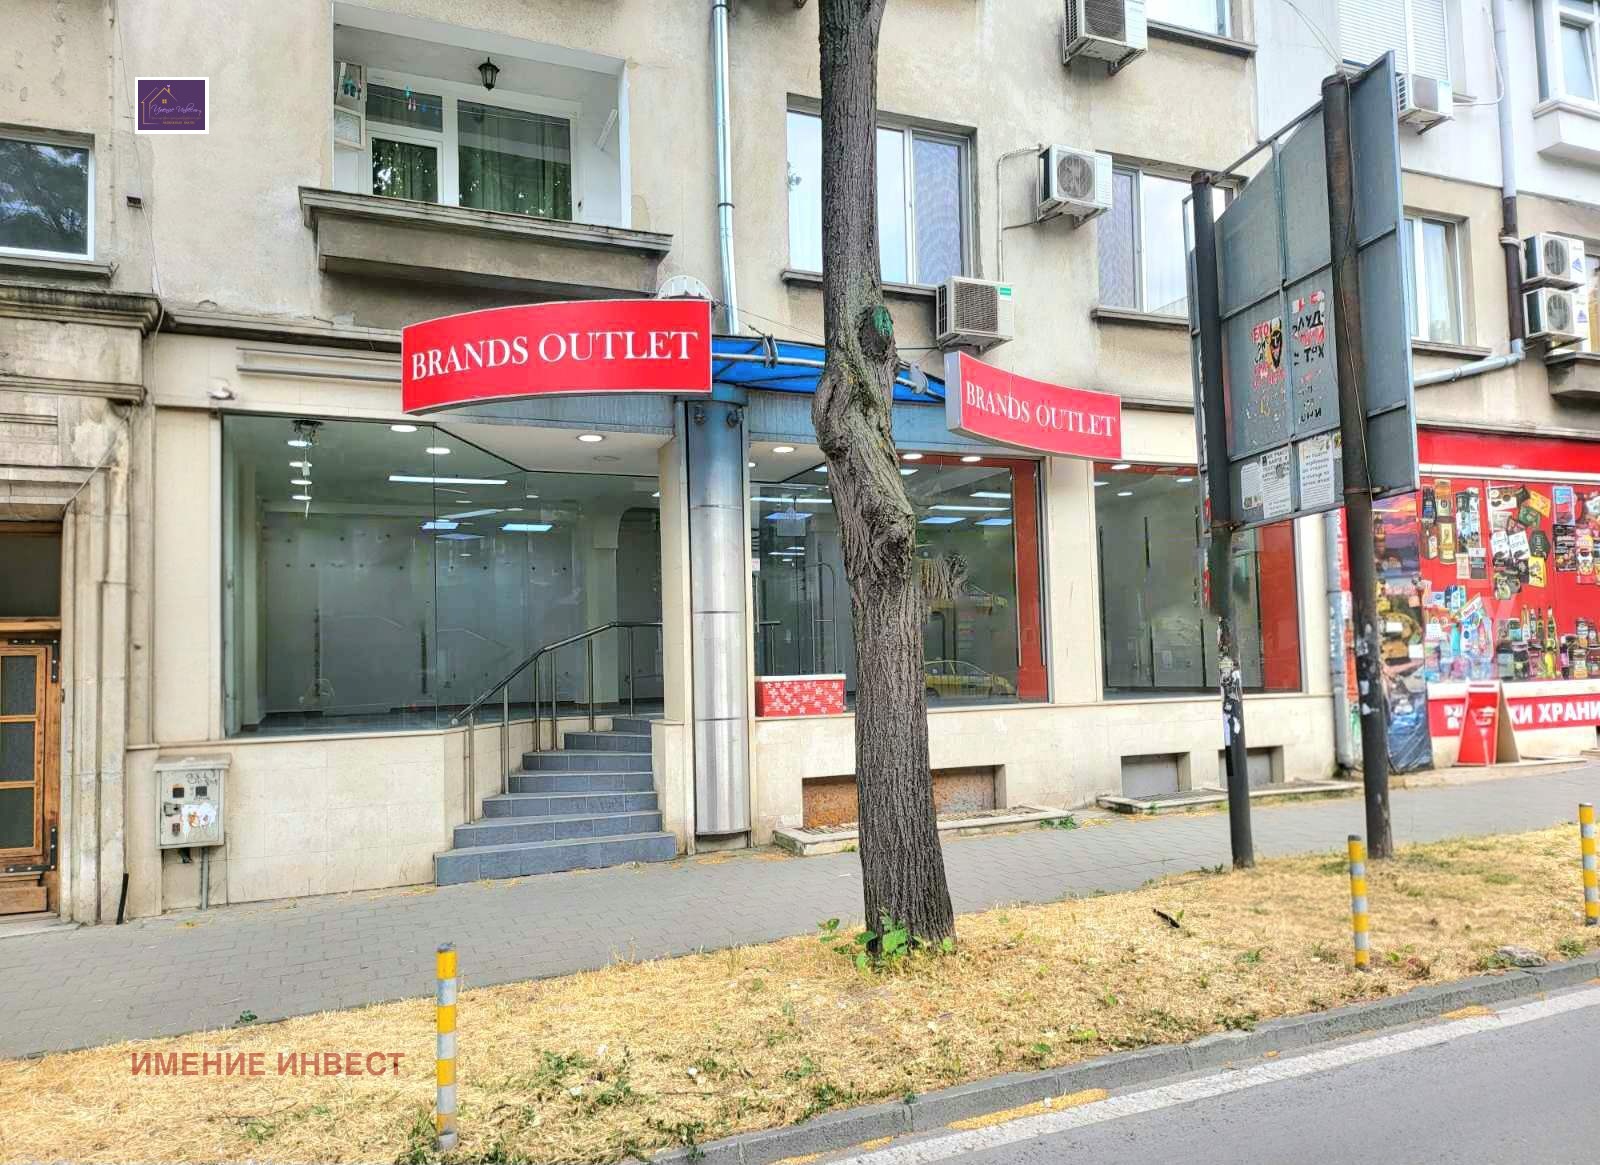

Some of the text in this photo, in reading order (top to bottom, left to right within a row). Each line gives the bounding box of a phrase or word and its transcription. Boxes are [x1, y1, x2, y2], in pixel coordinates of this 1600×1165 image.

[411, 331, 699, 381] BRANDS OUTLET
[966, 381, 1117, 437] BRANDS OUTLET
